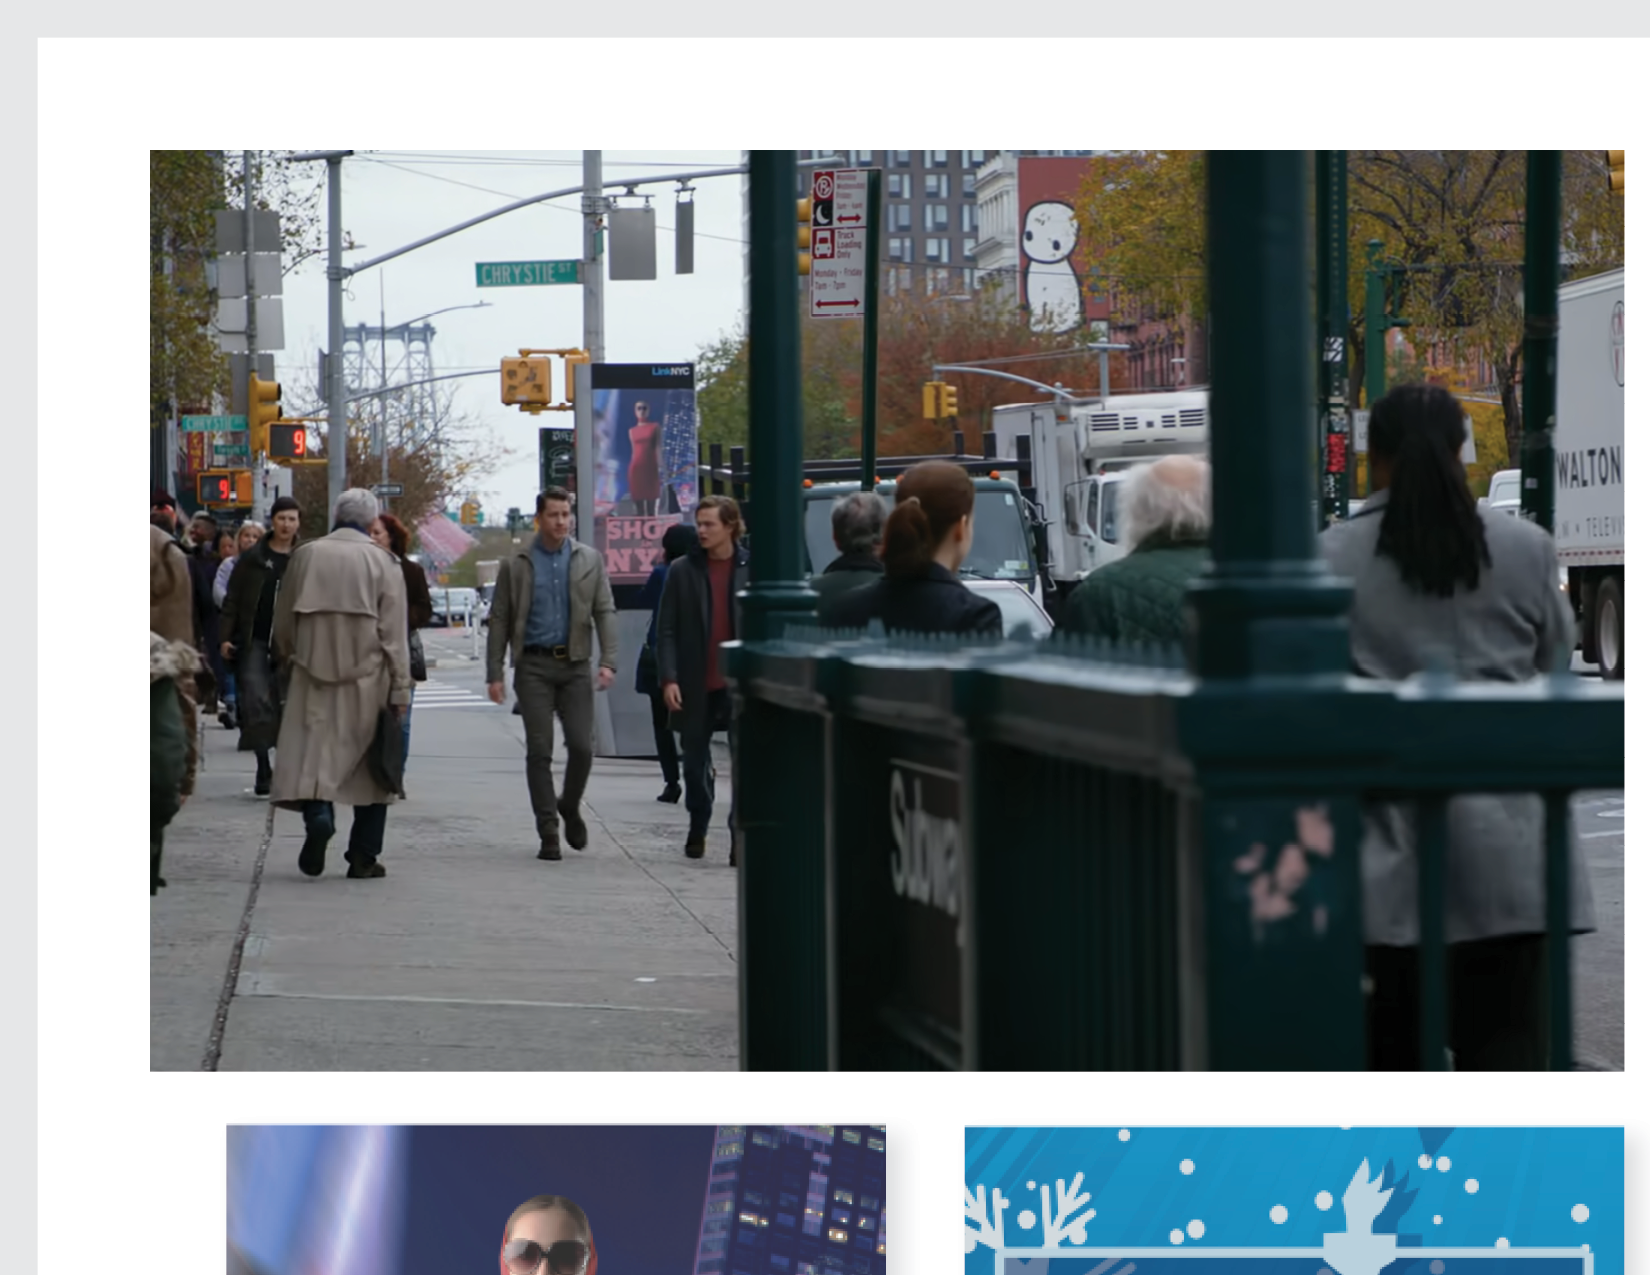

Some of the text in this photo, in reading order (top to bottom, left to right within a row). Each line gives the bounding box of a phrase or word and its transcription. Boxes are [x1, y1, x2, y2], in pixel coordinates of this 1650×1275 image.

[837, 240, 861, 250] Loading
[481, 262, 571, 285] CHRYSTIE ST
[294, 430, 305, 455] 9
[1556, 446, 1622, 488] WALTON
[218, 479, 229, 499] 9
[1586, 515, 1624, 538] TELEVI
[606, 548, 664, 572] NY
